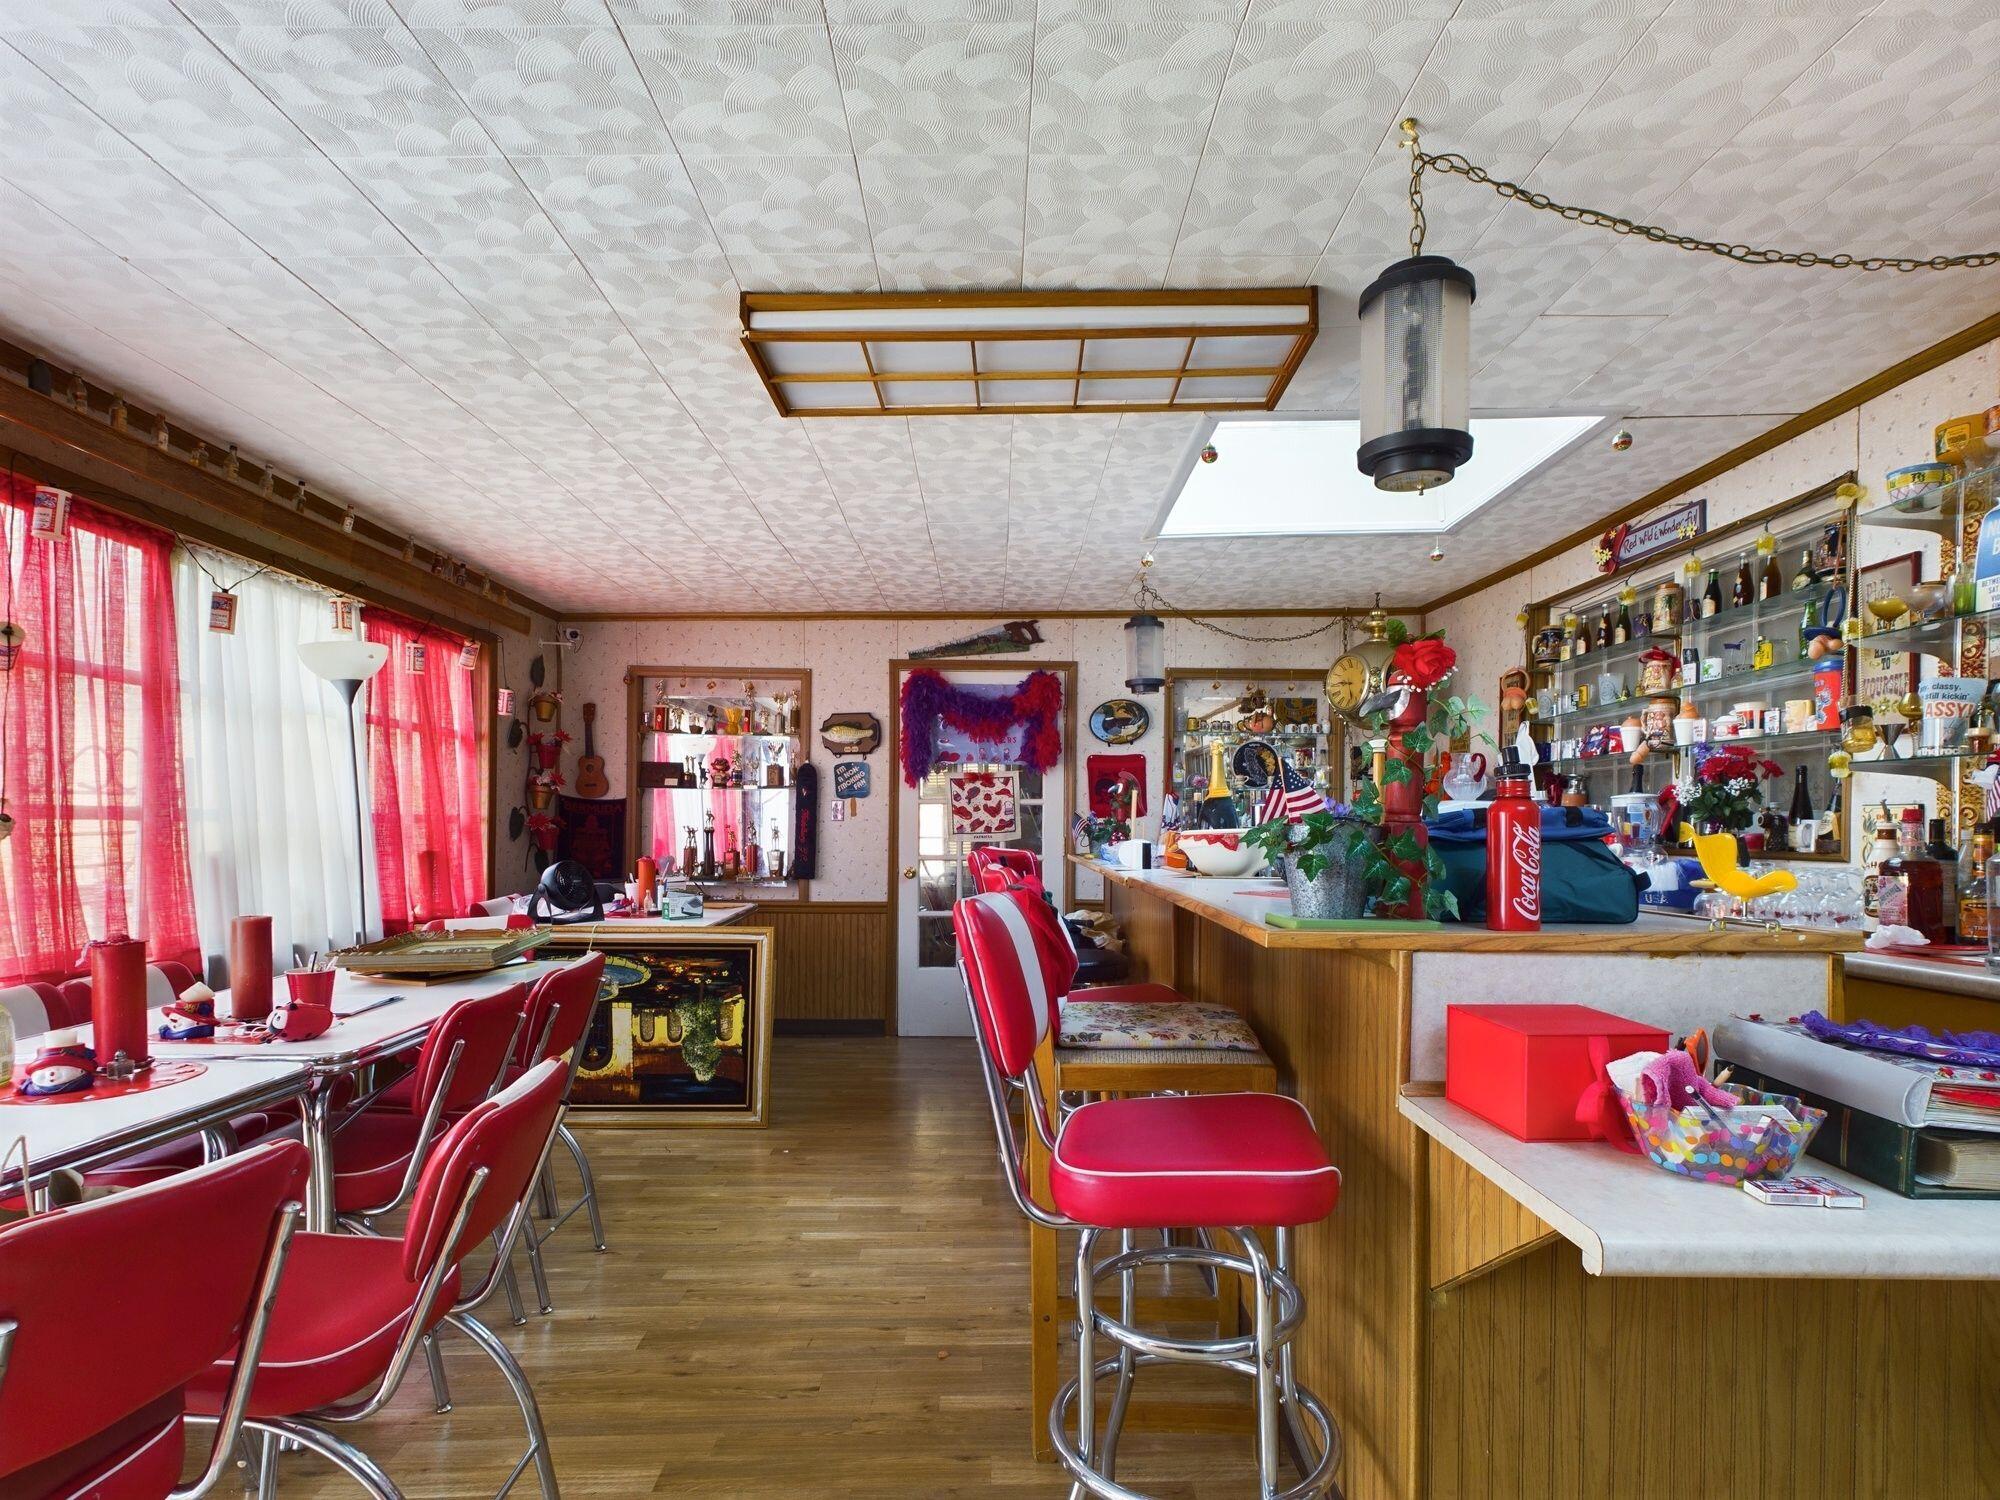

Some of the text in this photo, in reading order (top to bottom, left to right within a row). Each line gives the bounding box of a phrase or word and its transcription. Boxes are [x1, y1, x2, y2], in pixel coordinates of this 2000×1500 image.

[1623, 535, 1637, 554] Red
[838, 771, 865, 791] SMOKING
[854, 780, 866, 790] FAN
